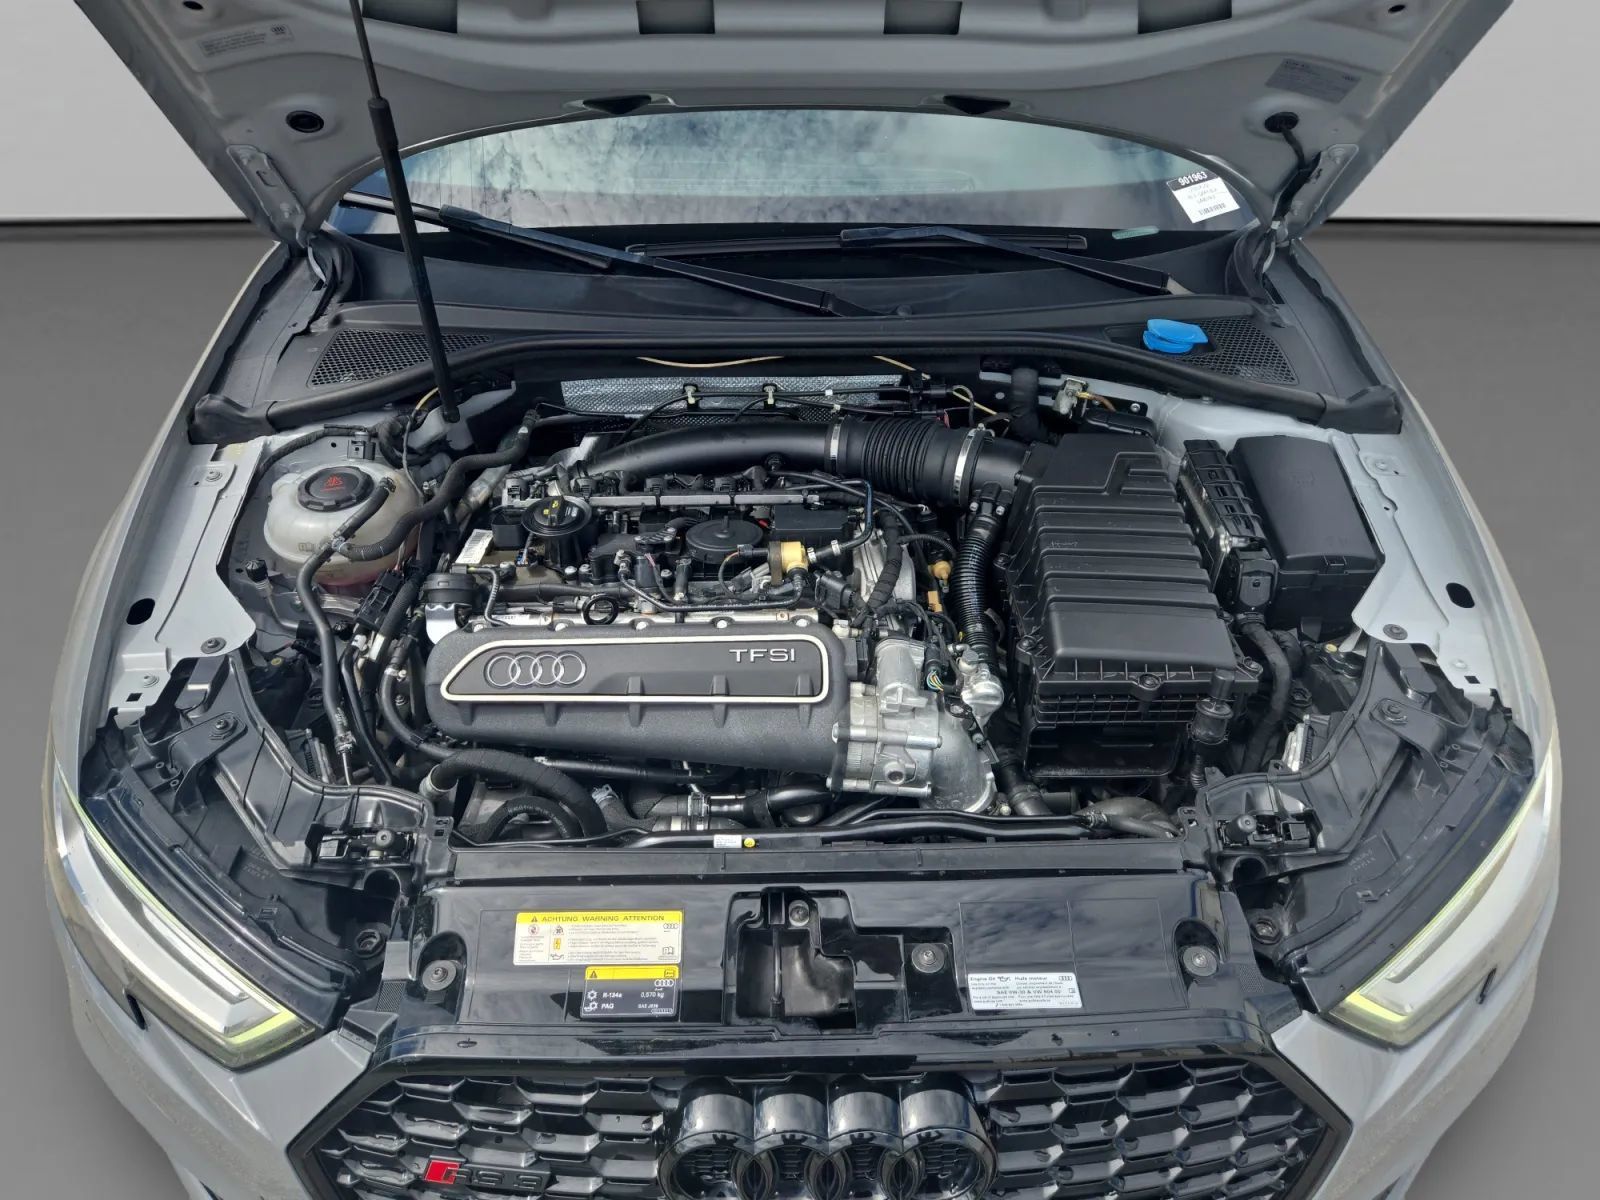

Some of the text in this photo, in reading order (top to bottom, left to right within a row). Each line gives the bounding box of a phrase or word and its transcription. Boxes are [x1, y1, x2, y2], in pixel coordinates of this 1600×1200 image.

[1178, 171, 1208, 186] 901963
[728, 648, 797, 664] TFSI
[657, 991, 665, 999] kg
